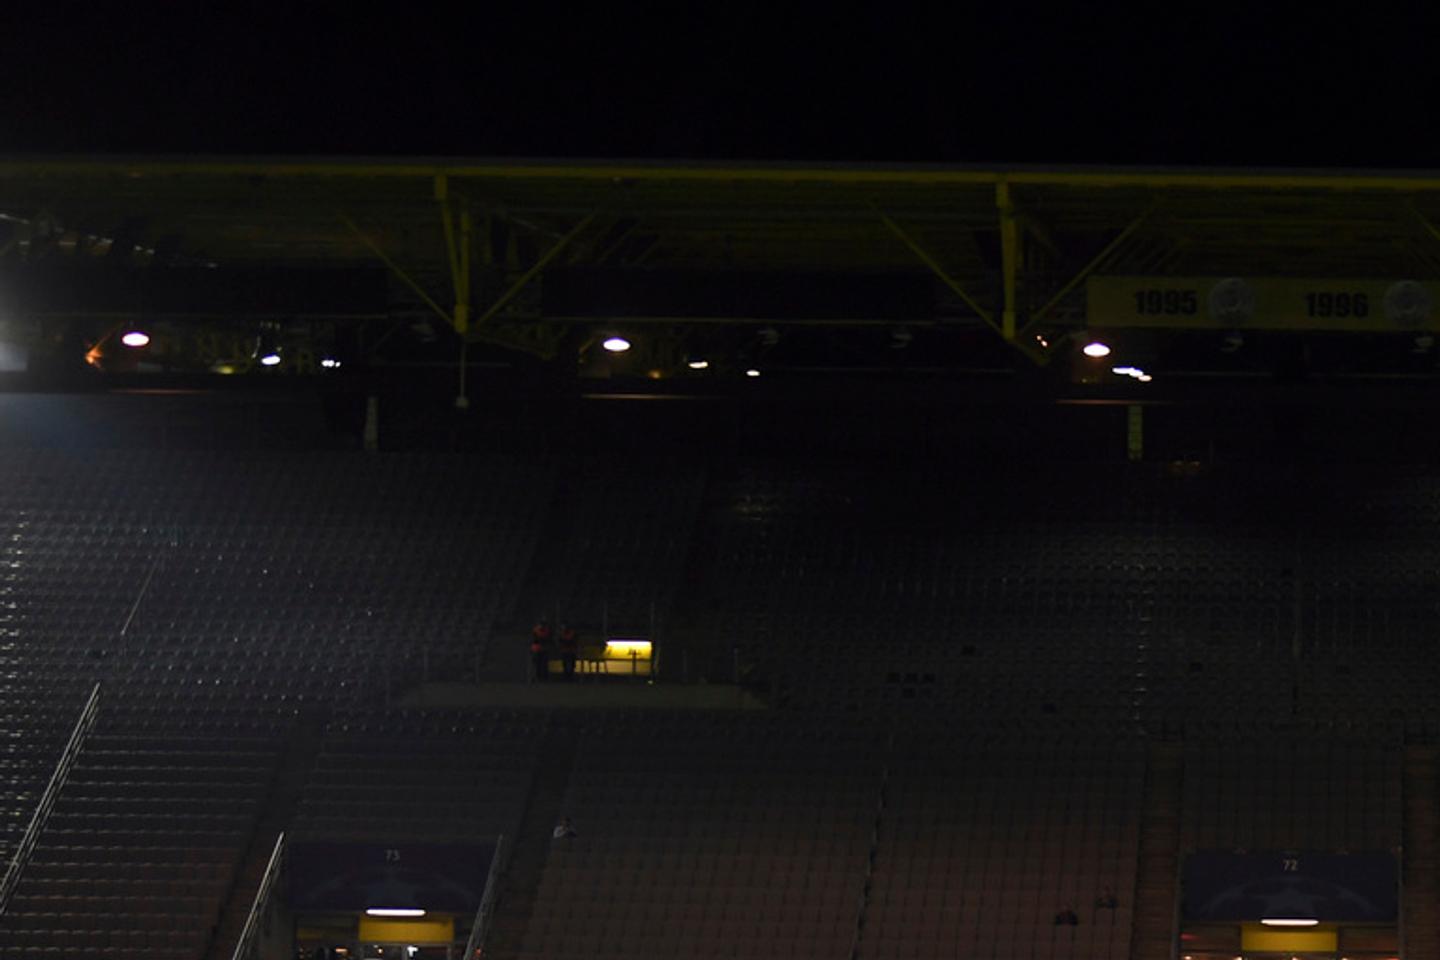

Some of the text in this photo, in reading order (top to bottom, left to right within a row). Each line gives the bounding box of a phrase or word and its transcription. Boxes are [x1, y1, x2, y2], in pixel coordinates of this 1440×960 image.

[1135, 290, 1369, 318] 1995 1996
[1282, 858, 1299, 872] 72
